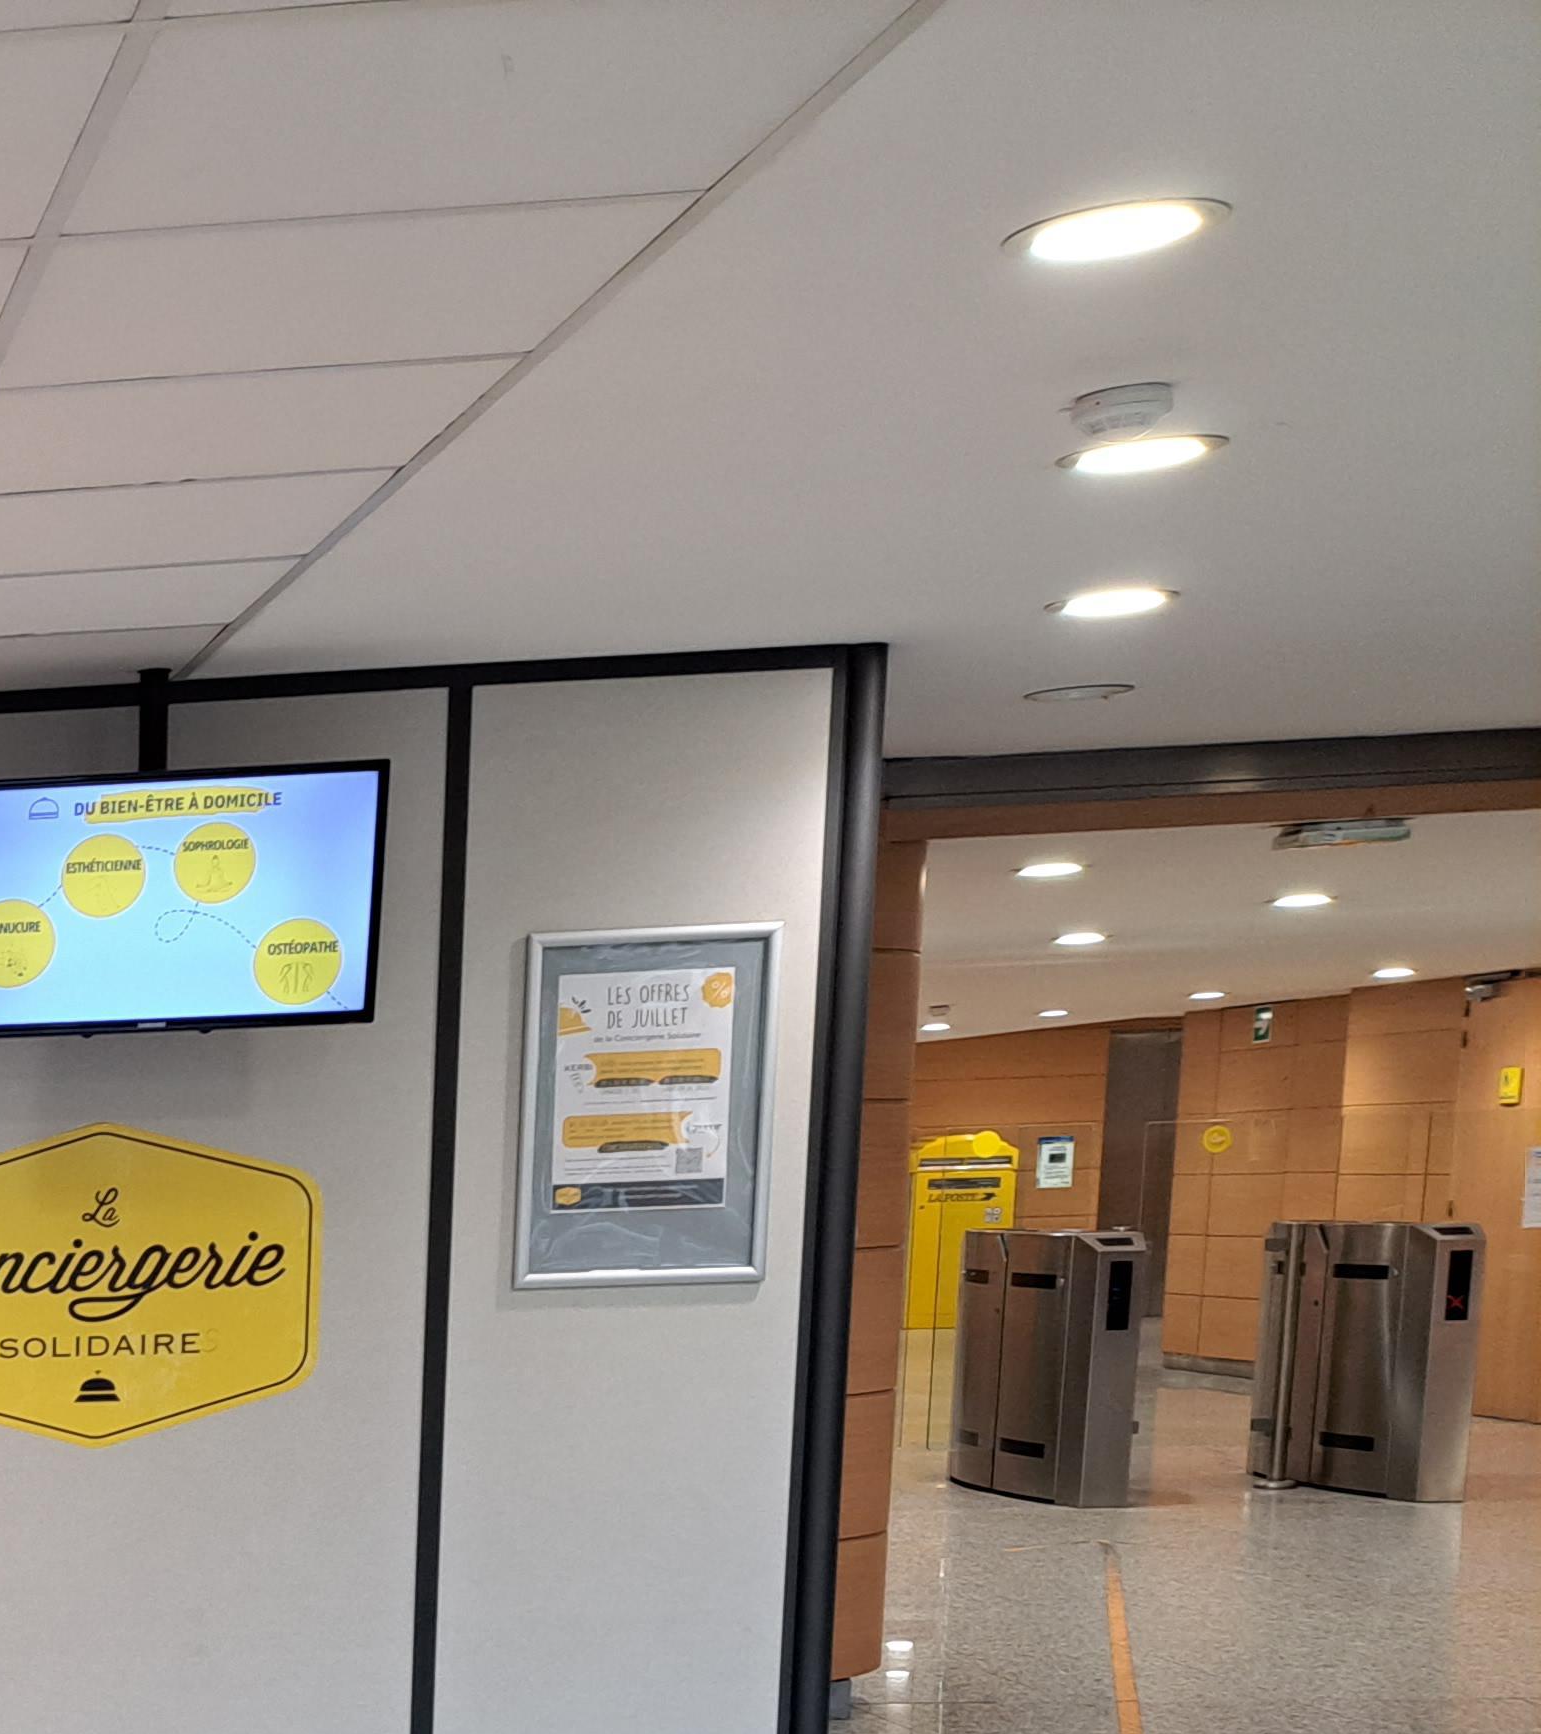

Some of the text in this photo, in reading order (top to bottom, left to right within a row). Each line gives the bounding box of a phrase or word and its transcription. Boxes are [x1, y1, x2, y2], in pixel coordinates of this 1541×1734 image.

[74, 792, 282, 816] DU BIEN-ÊTRE À DOMICILE
[181, 838, 250, 852] SOPHROLOGIE
[66, 857, 142, 874] ESTHÉTICIENNE
[267, 937, 339, 956] OSTÉOPATHE
[607, 983, 691, 1006] LES OFFRES
[607, 1007, 688, 1029] DE JUILLET
[81, 1187, 120, 1228] La
[928, 1193, 944, 1203] LA
